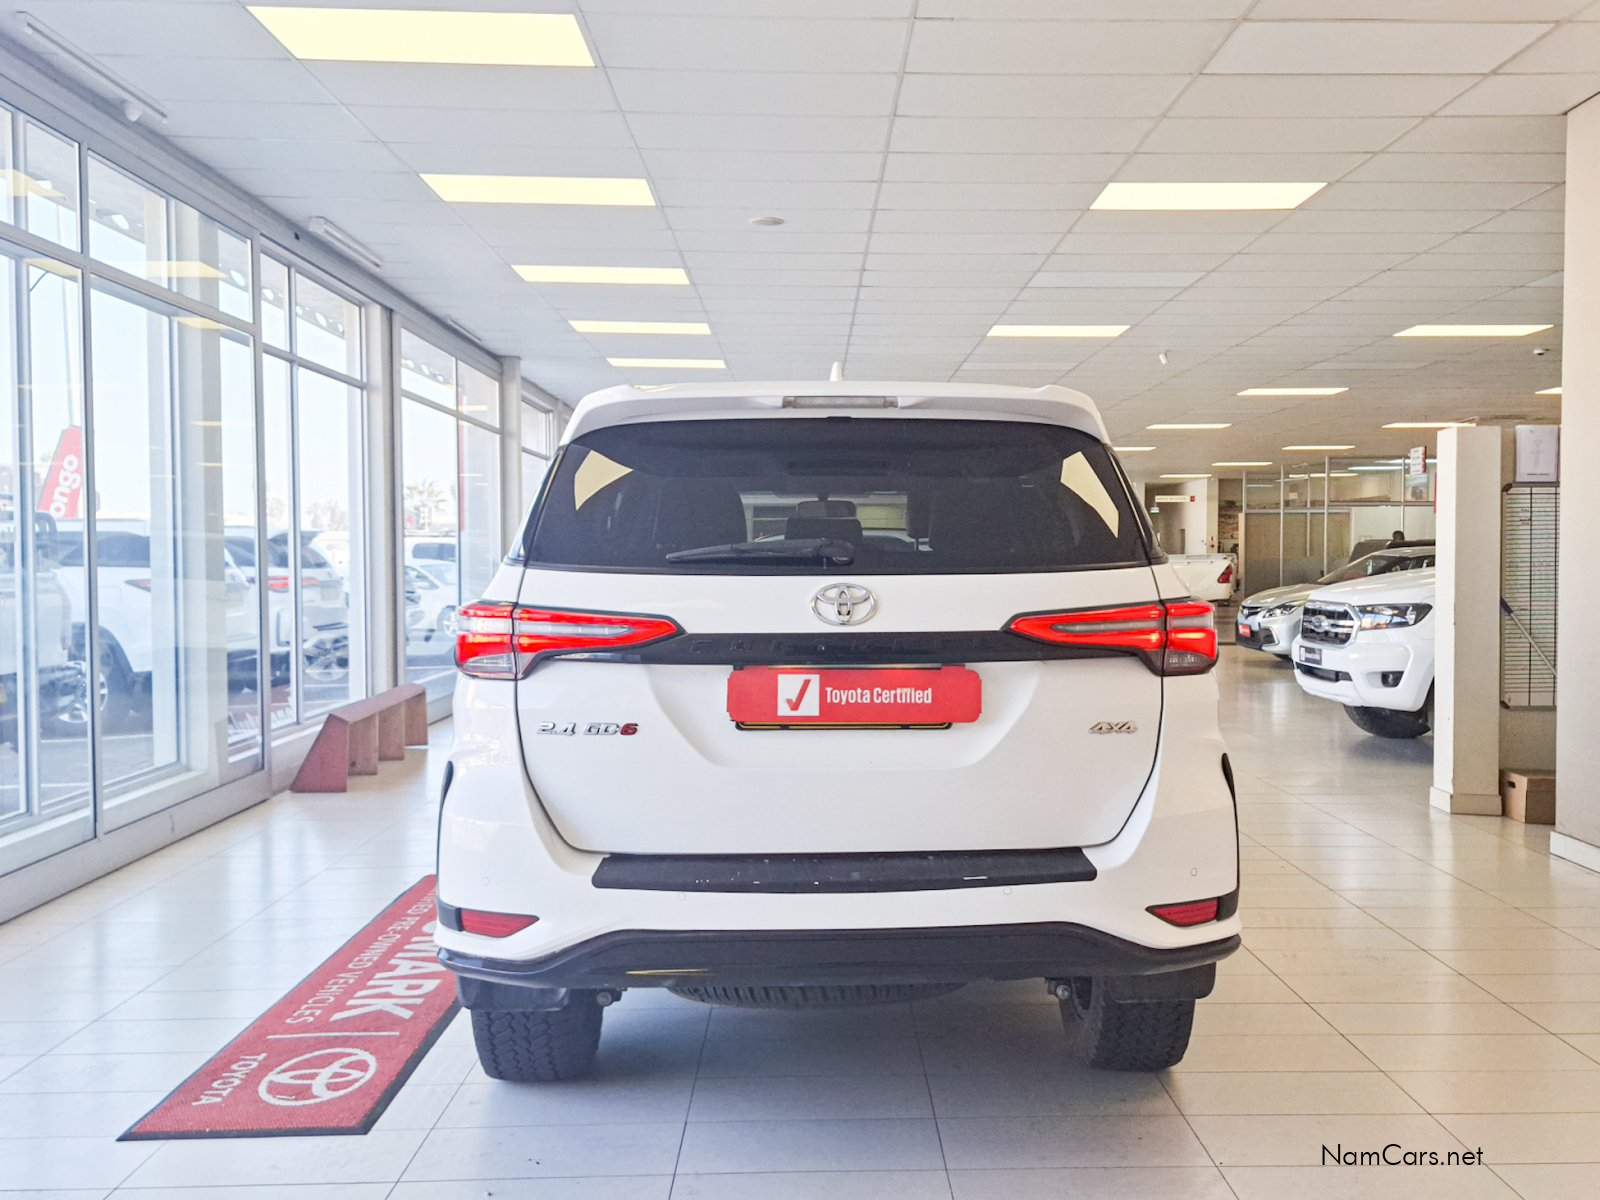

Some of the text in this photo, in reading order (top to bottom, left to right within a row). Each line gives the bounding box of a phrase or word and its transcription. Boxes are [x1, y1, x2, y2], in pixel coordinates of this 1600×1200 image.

[825, 687, 933, 705] Toyota Certified
[537, 721, 639, 736] 2.4 GD6
[286, 970, 363, 1024] VEHICLES
[329, 919, 448, 1022] MARK
[191, 1053, 268, 1106] TOYOTA
